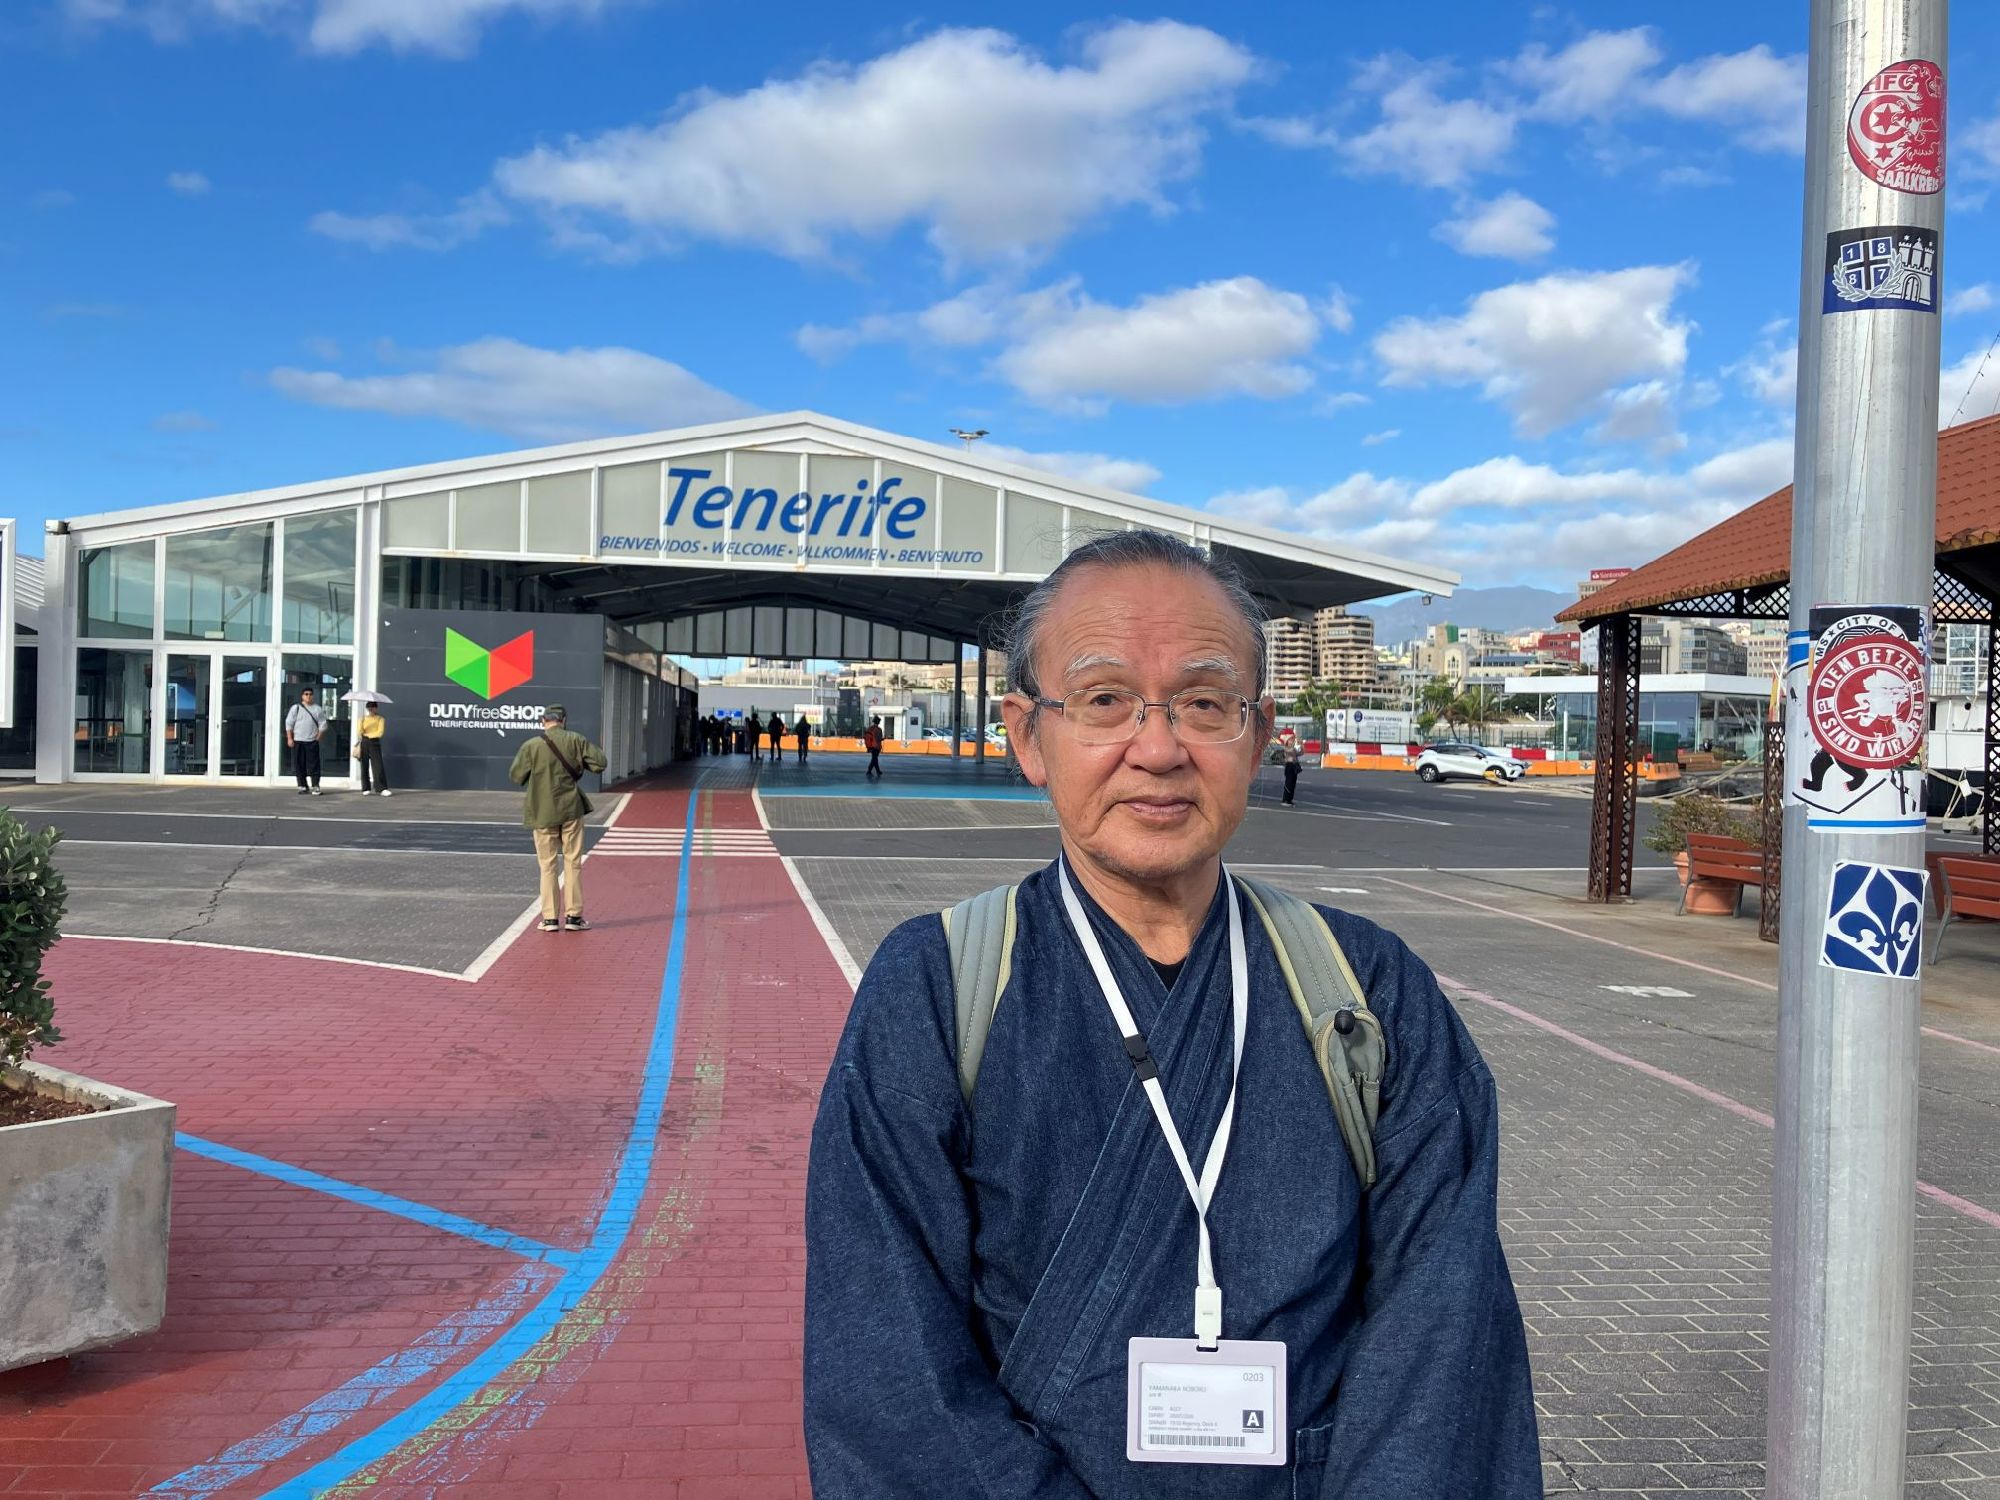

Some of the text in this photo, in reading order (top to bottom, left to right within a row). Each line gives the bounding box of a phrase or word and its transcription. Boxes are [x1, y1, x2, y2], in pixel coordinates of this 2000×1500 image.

[1876, 169, 1939, 192] SAALKREIS
[1846, 242, 1886, 260] 1 8
[1848, 269, 1887, 285] 8 7
[663, 468, 926, 539] Tenerife
[599, 535, 701, 554] BIENVENIDOS
[711, 541, 786, 558] WELCOME
[897, 549, 983, 564] BENVENUTO
[1836, 616, 1872, 631] CITY
[1878, 618, 1898, 633] OF
[1820, 648, 1914, 690] DEM BETZE
[1911, 679, 1923, 693] 98
[429, 703, 546, 720] DUTYfreeSHOP
[1817, 699, 1832, 712] GL
[429, 720, 546, 730] TENERIFECRUISETERMINAL
[1821, 715, 1861, 753] SIND
[1242, 1372, 1264, 1382] 0203
[1246, 1411, 1260, 1427] A
